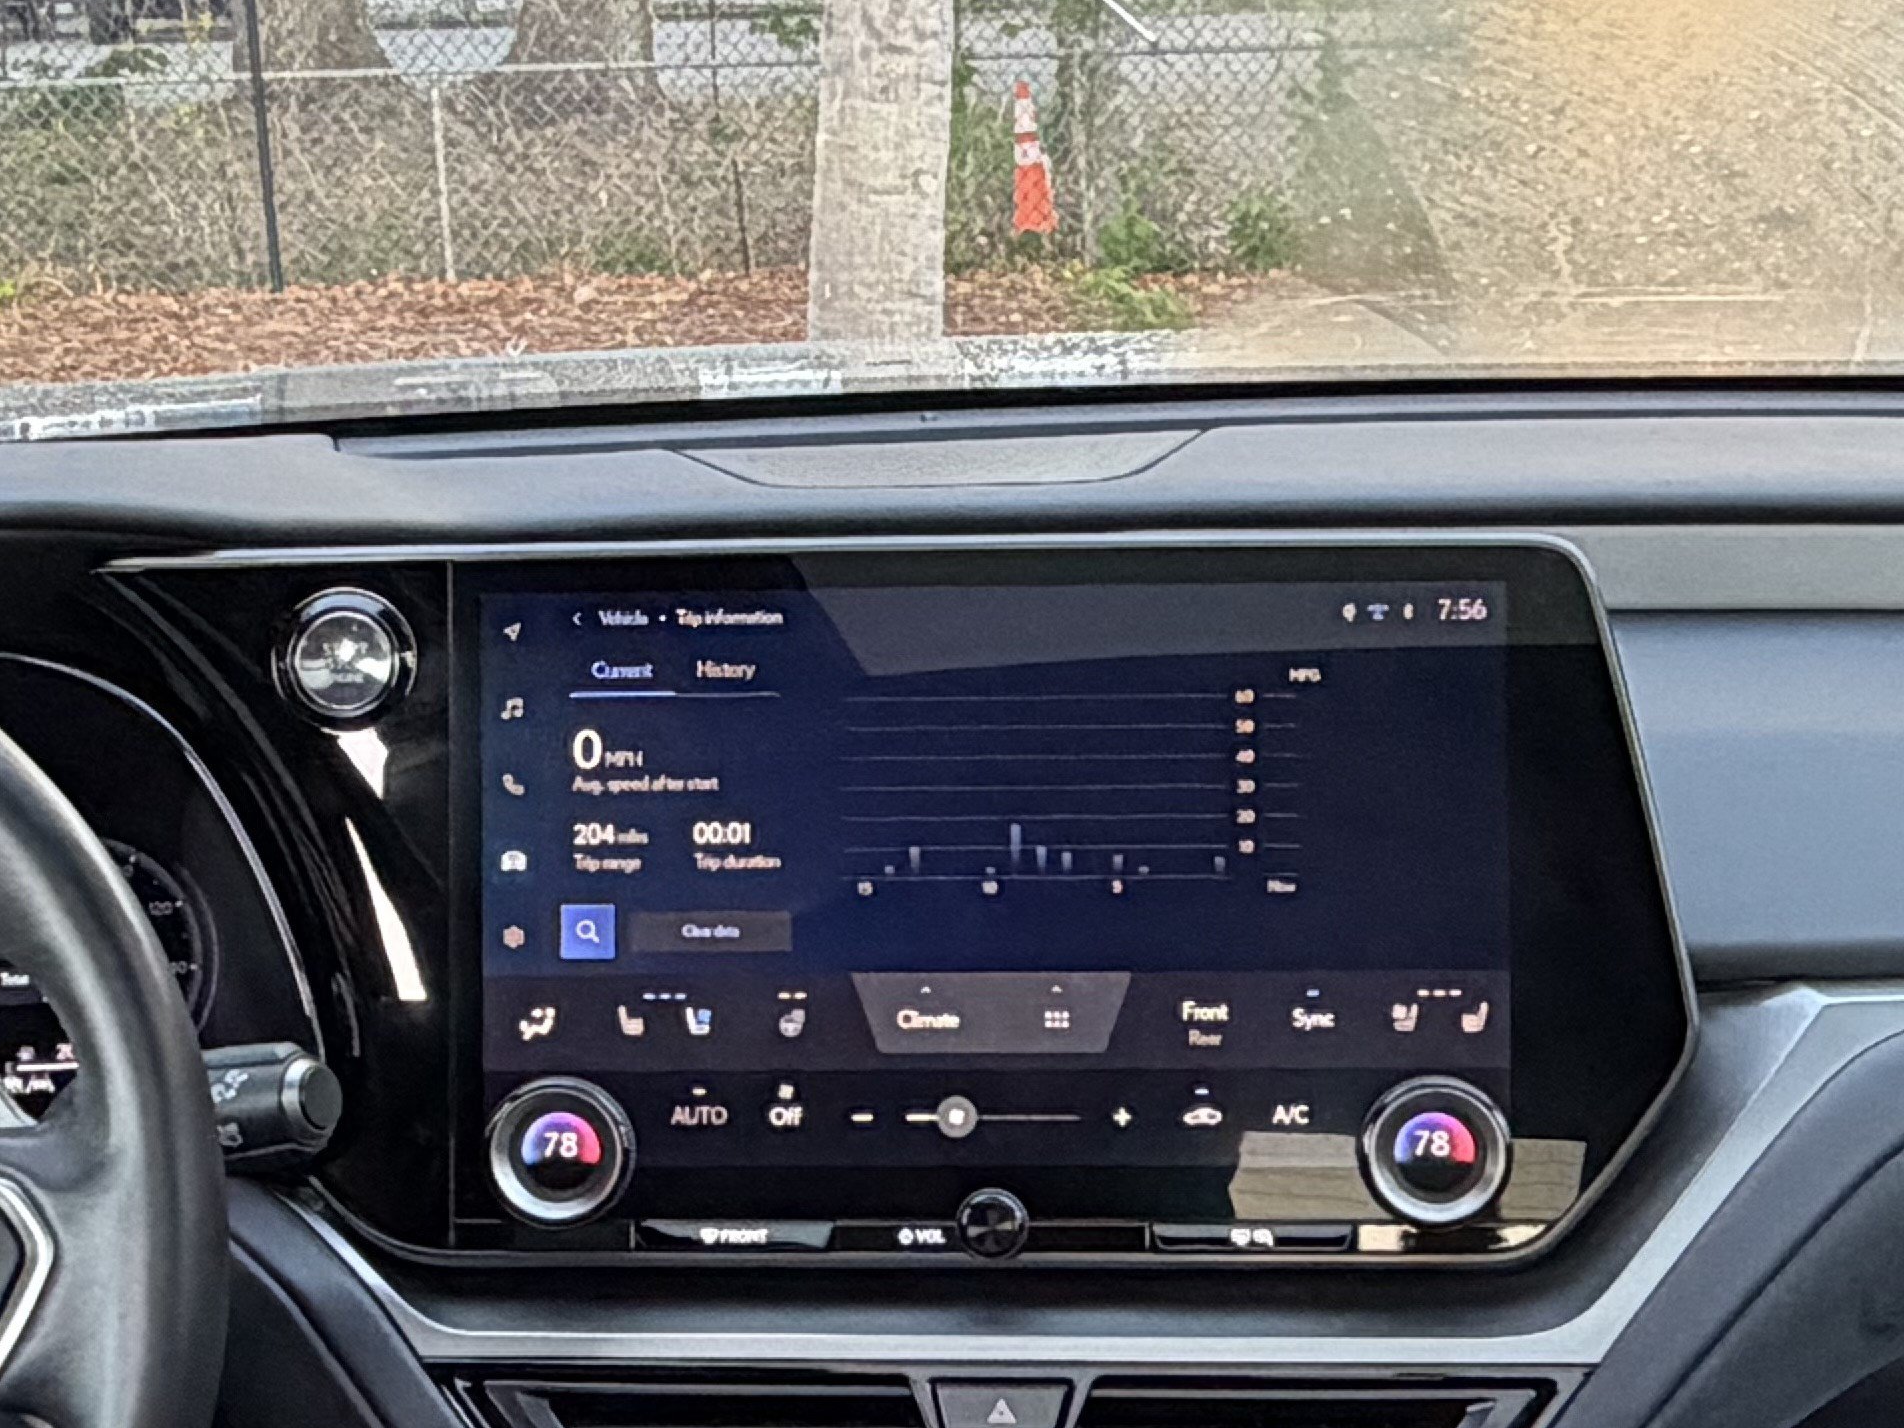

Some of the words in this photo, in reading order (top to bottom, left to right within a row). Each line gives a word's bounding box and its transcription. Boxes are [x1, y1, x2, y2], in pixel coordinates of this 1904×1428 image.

[1437, 598, 1488, 621] 7:56
[591, 660, 653, 679] Current
[696, 660, 756, 680] History
[572, 728, 603, 770] 0
[573, 823, 615, 845] 204
[692, 822, 752, 845] 00:01
[896, 1009, 961, 1030] Climate
[1181, 1000, 1230, 1023] Front
[1291, 1008, 1336, 1031] Sync
[1188, 1030, 1223, 1047] Rear
[670, 1105, 728, 1126] AUTO
[768, 1104, 804, 1126] Off
[1271, 1104, 1310, 1125] A/C
[543, 1132, 578, 1158] 78
[1413, 1131, 1451, 1158] 78
[914, 1228, 947, 1245] VOL
